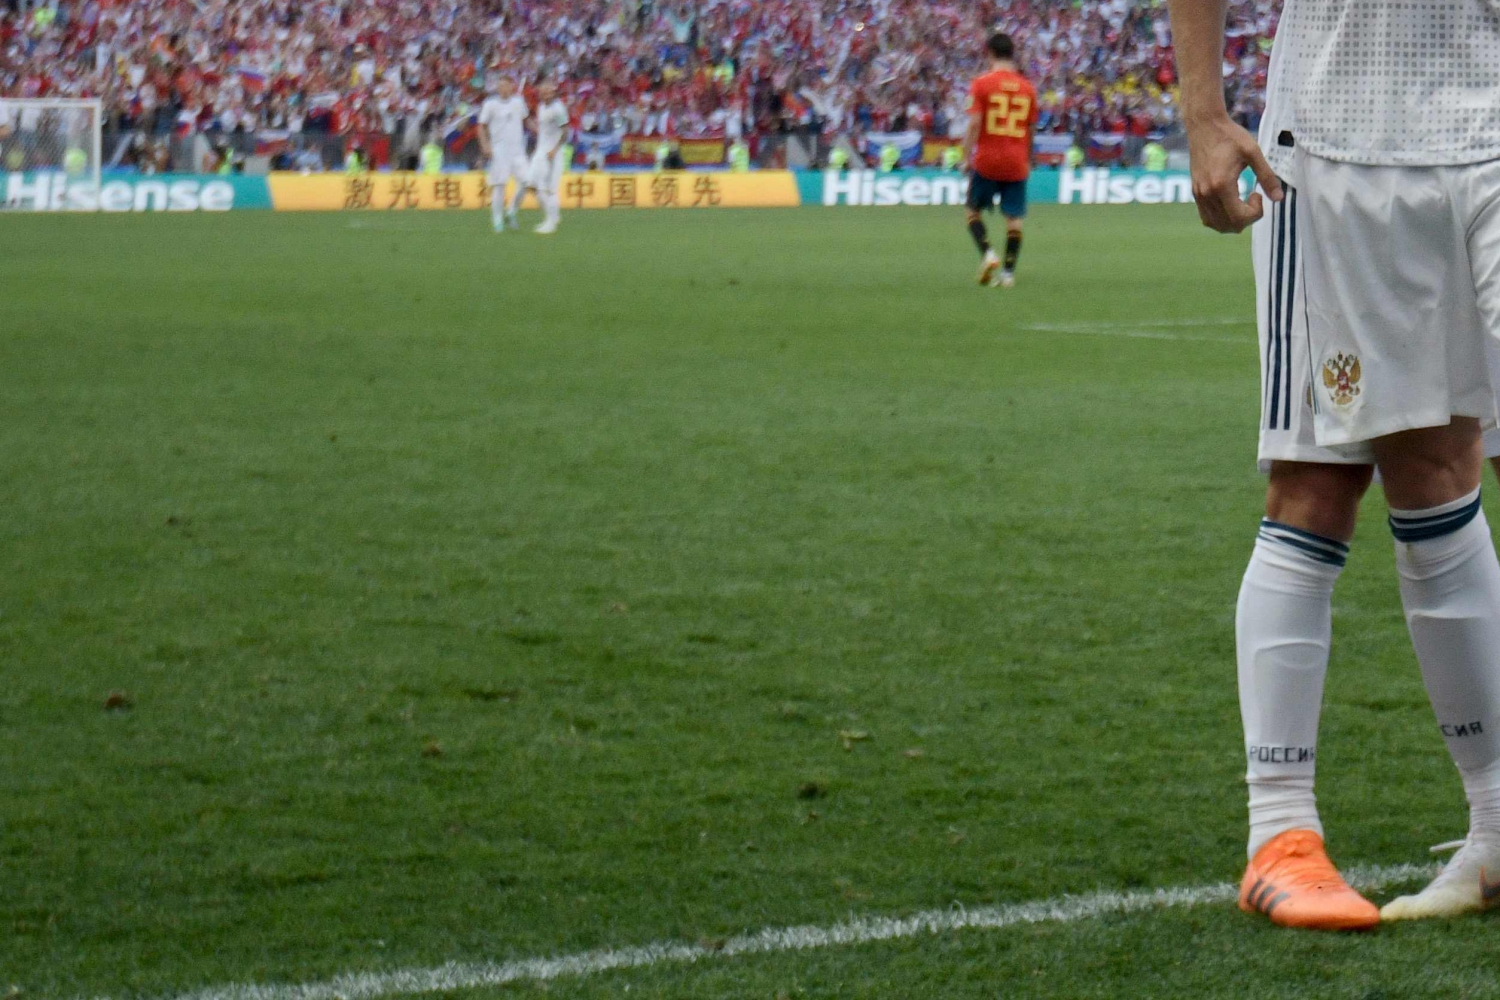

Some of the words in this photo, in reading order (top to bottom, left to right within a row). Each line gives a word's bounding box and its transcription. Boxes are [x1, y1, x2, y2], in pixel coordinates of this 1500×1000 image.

[986, 94, 1031, 138] 22
[6, 171, 234, 212] Hisense
[566, 177, 721, 208] 中国领先
[823, 168, 970, 206] Hisen
[1060, 166, 1192, 205] Hisen
[1440, 721, 1483, 738] СИЯ
